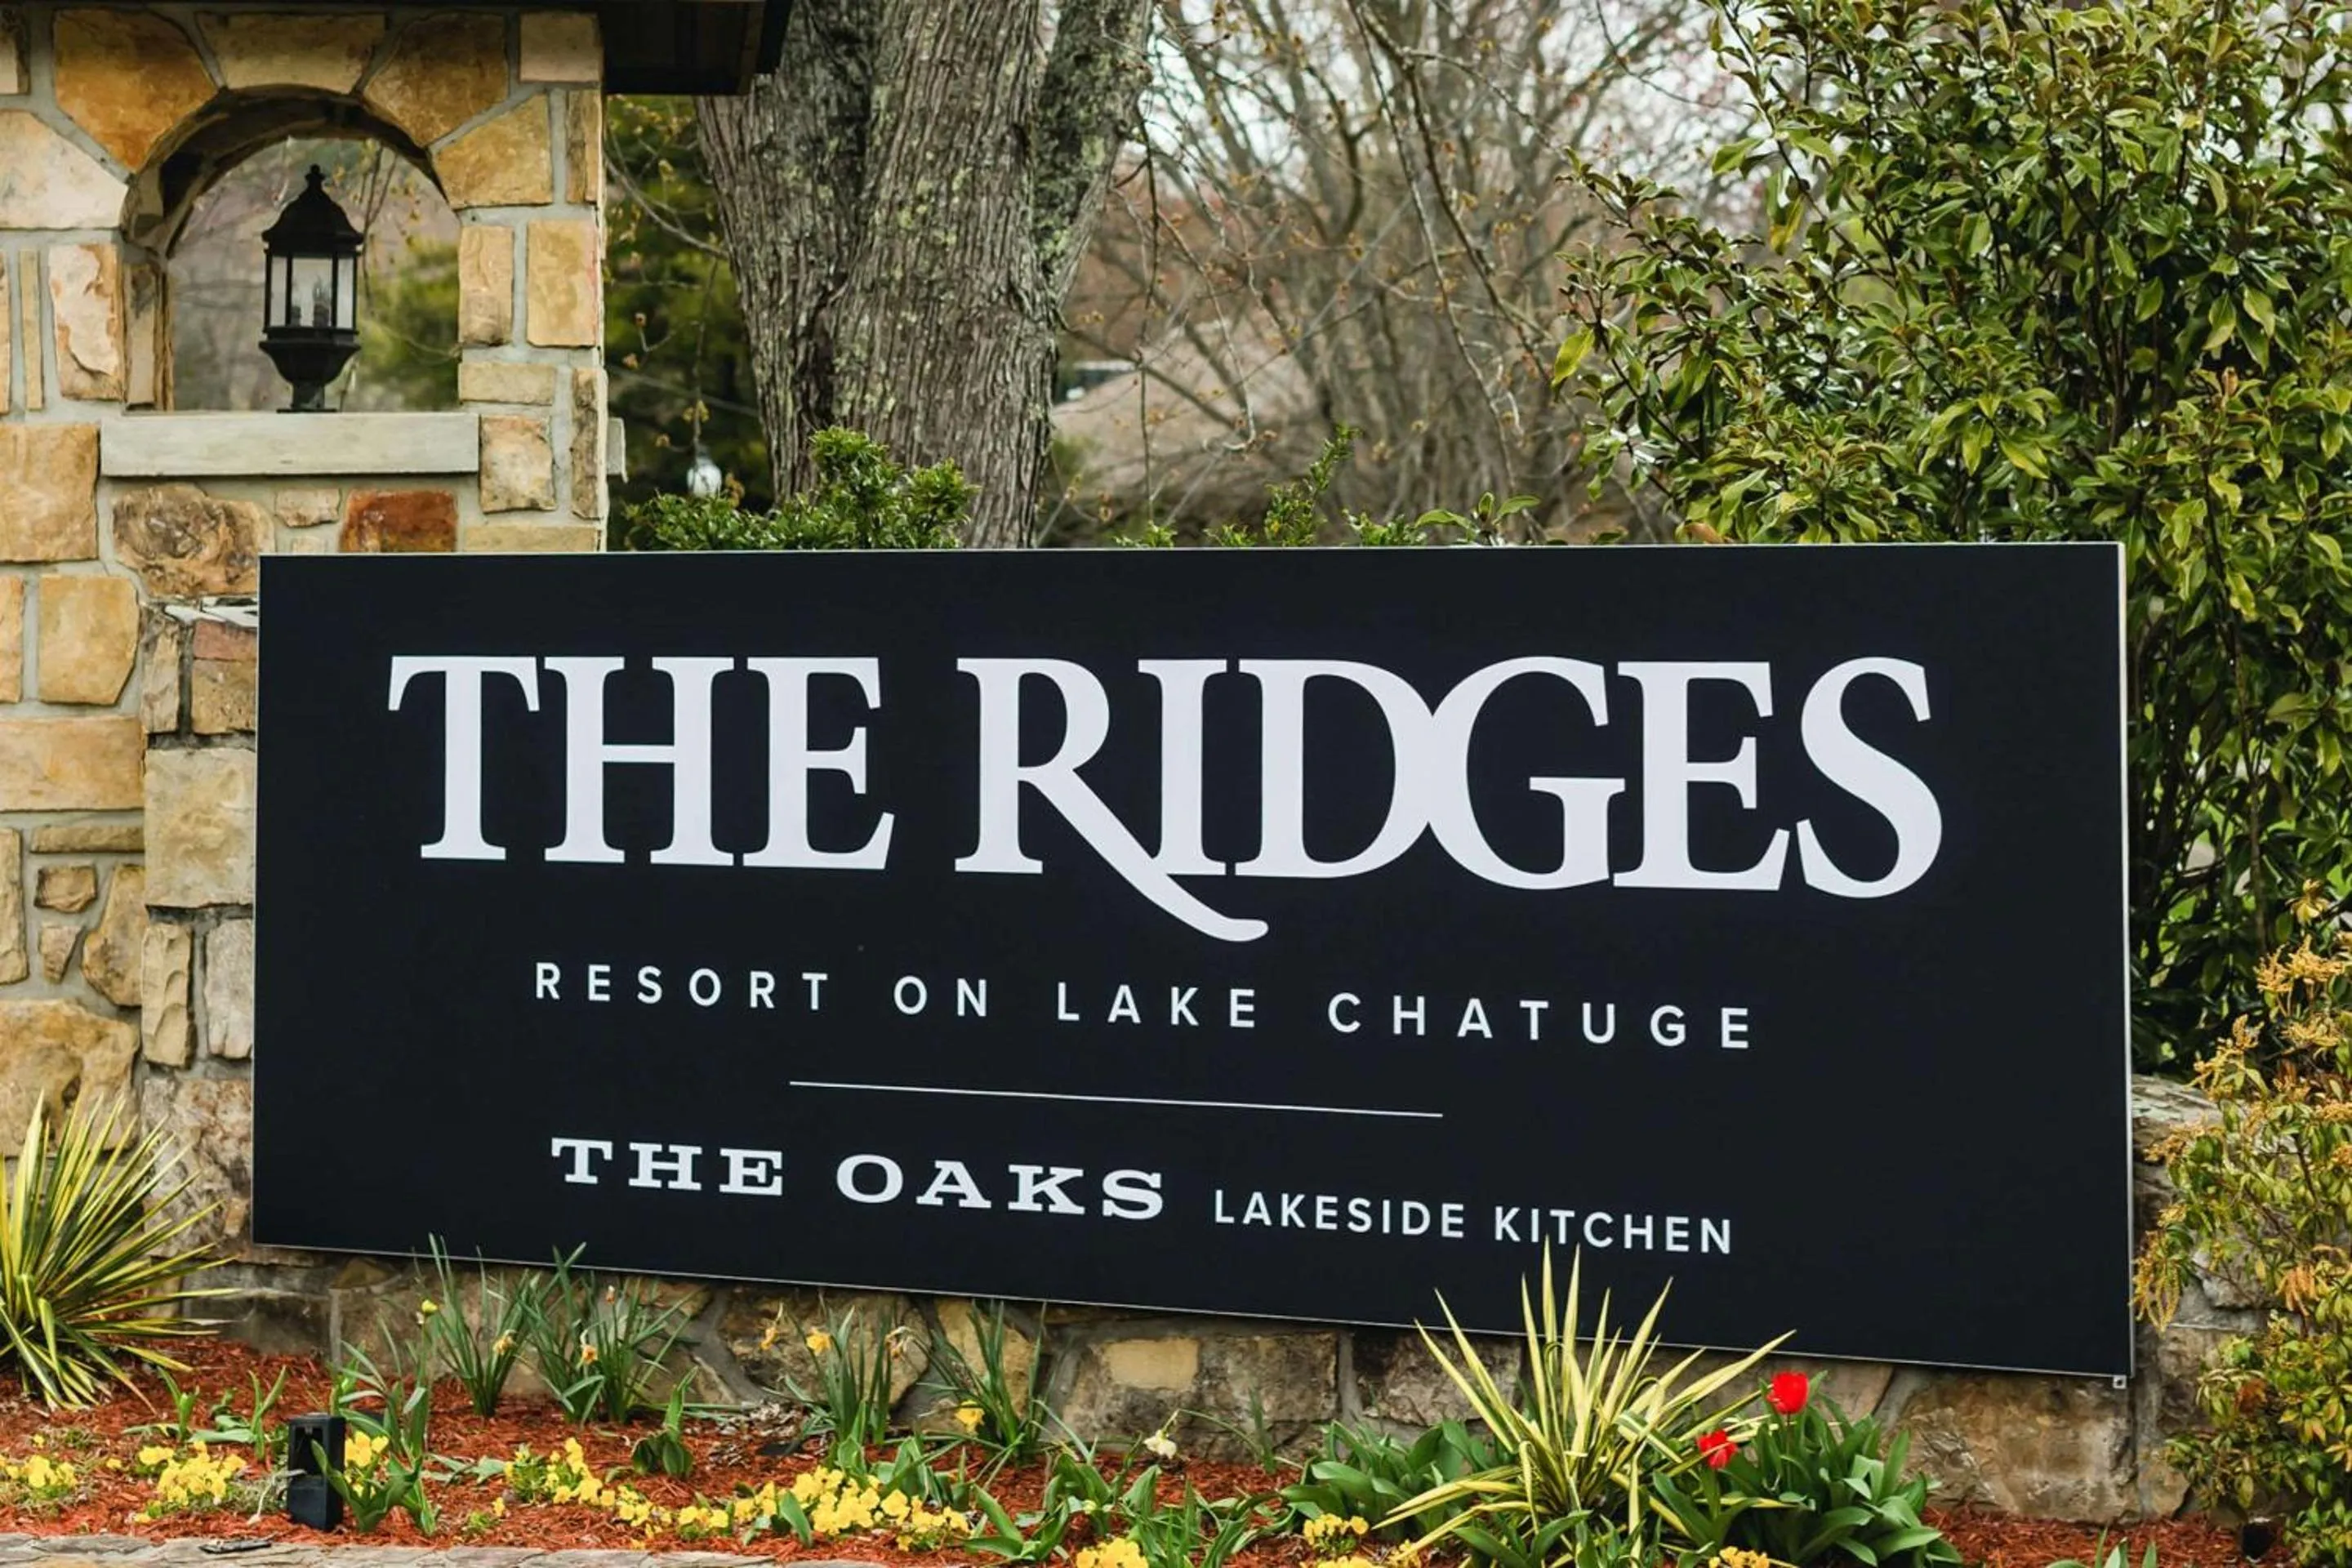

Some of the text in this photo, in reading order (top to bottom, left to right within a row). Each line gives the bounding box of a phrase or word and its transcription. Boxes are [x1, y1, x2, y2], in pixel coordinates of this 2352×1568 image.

[388, 655, 1943, 942] THE RIDGES
[536, 961, 1750, 1049] RESORT ON LAKE CHATUGE
[550, 1138, 1731, 1255] THE OAKS LAKESIDE KITCHEN
